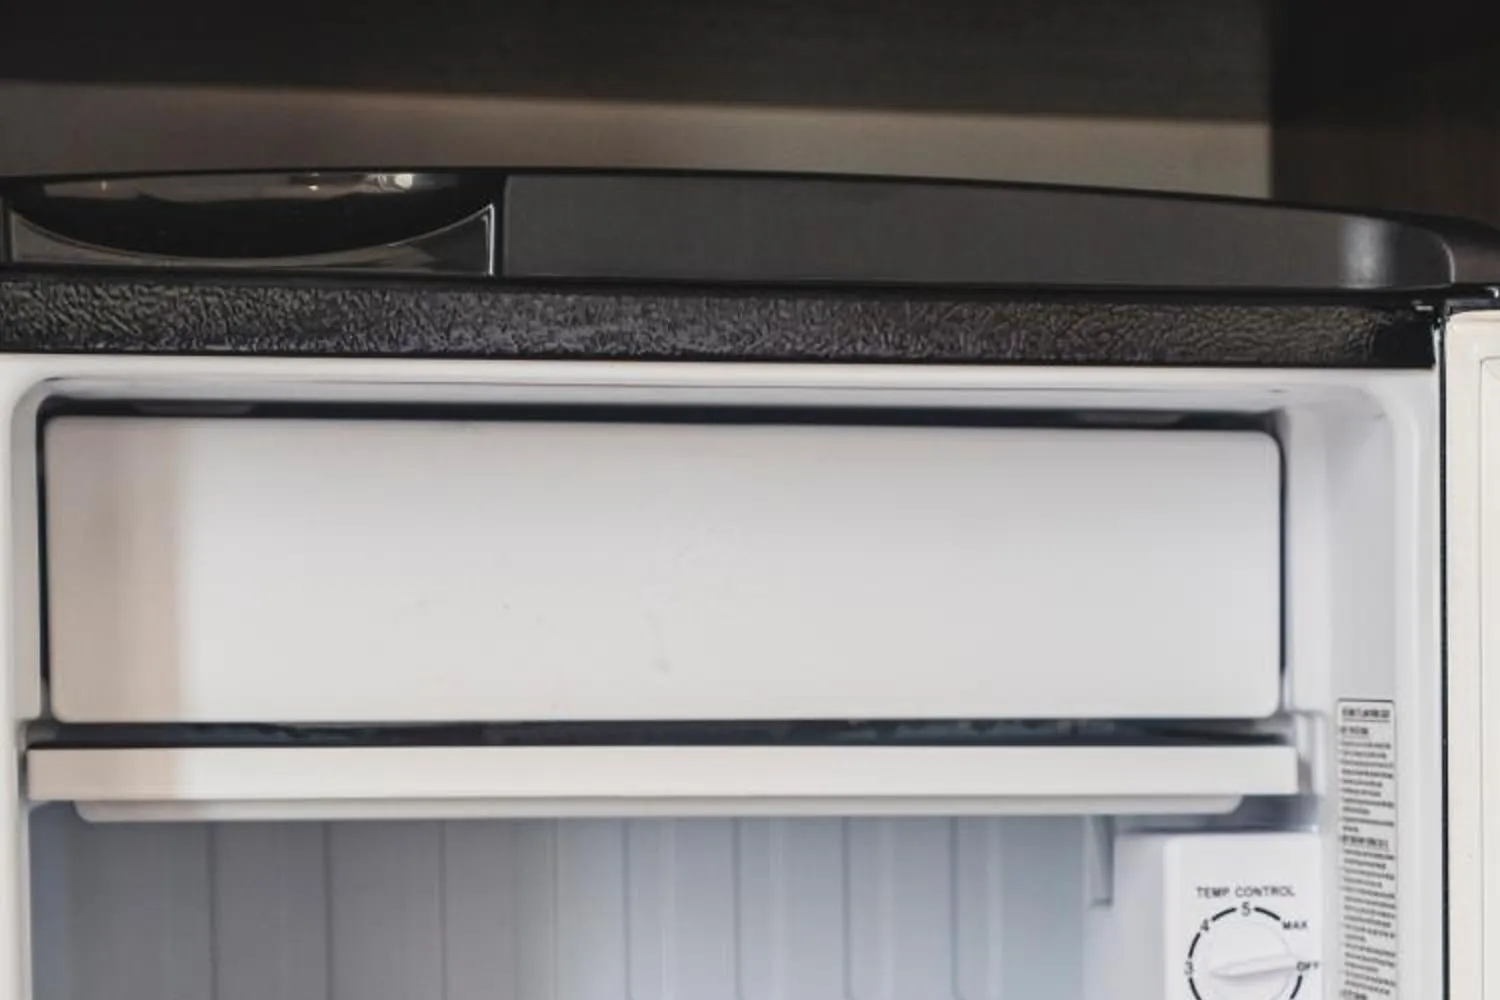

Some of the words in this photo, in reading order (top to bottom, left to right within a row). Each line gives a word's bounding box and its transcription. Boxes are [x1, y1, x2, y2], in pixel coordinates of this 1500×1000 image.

[1196, 886, 1230, 899] TEMP
[1235, 886, 1296, 898] CONTROL
[1241, 902, 1250, 917] 5
[1200, 920, 1210, 932] 4
[1282, 921, 1308, 930] MAX
[1184, 961, 1194, 976] 3
[1296, 961, 1319, 972] OFF
